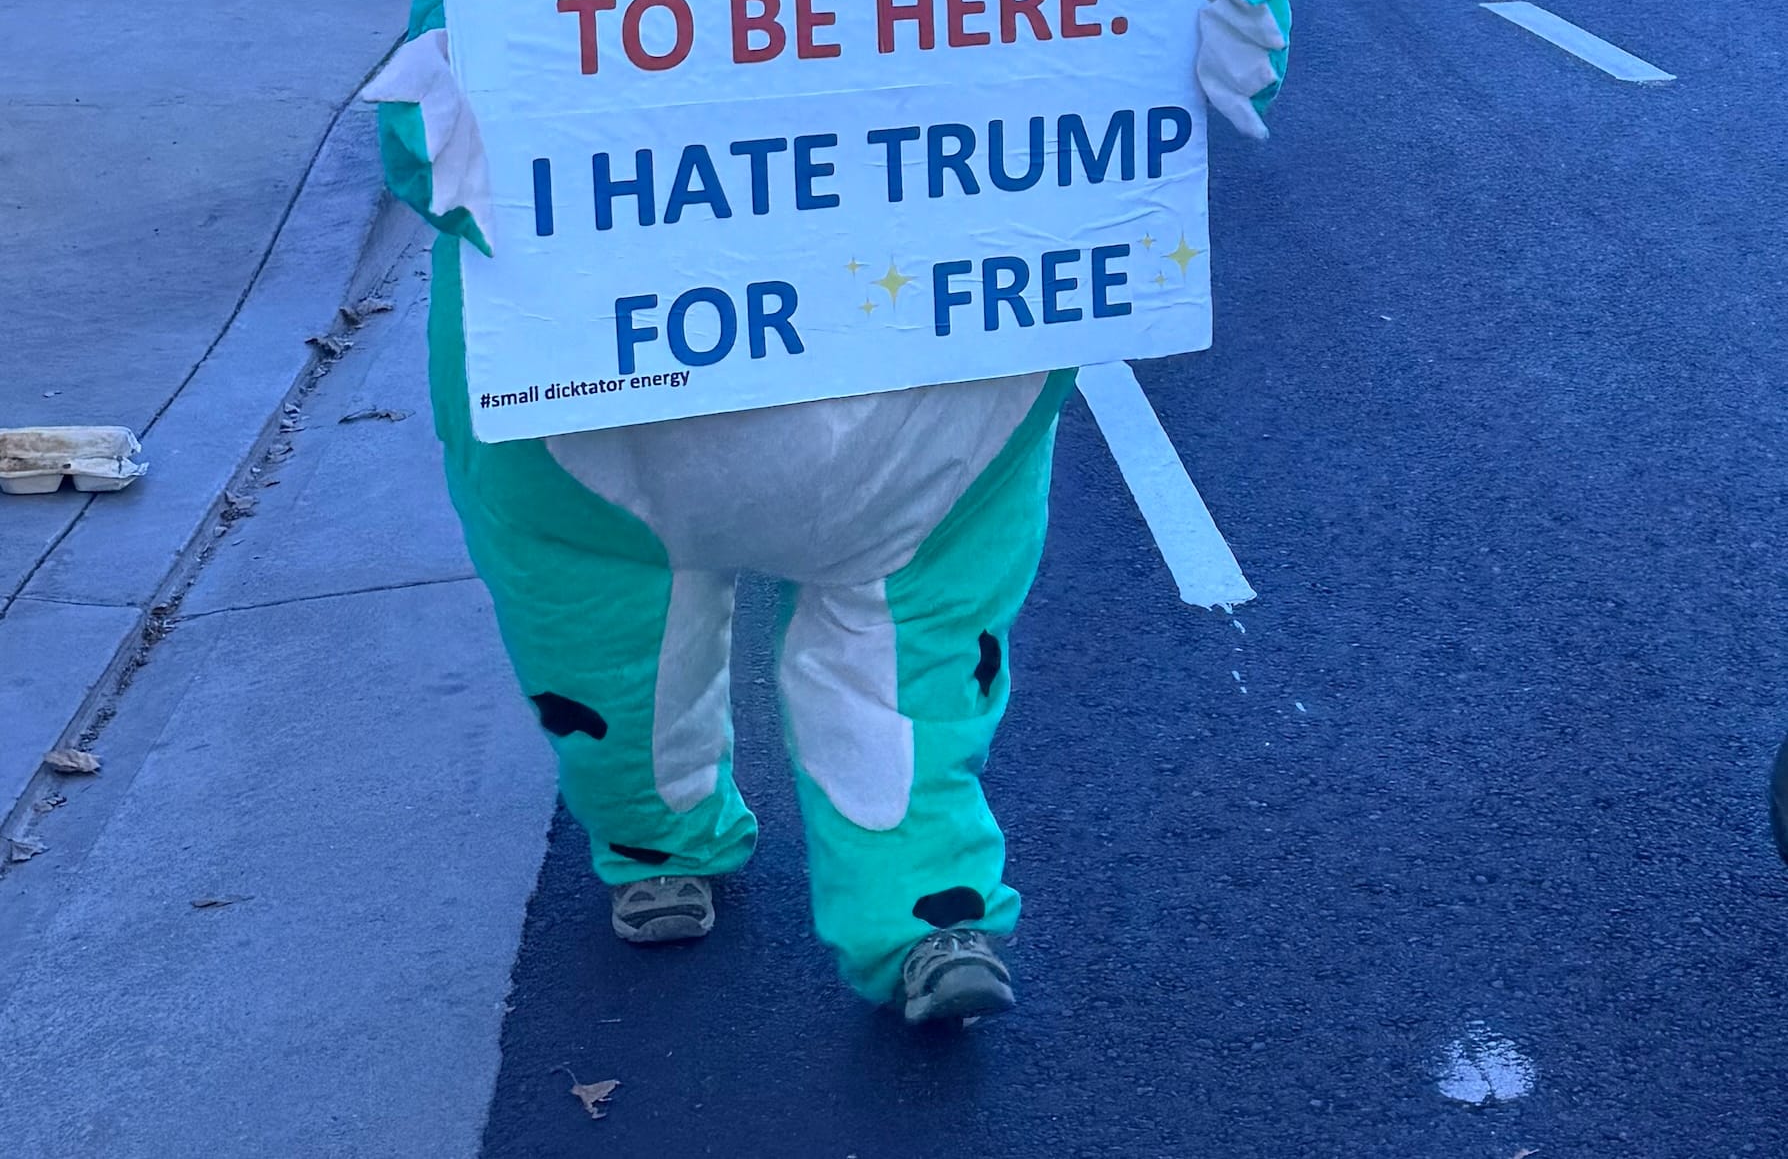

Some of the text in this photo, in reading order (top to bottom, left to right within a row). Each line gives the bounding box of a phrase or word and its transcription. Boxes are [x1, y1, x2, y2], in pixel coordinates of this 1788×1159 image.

[533, 106, 1193, 238] I HATE TRUMP
[615, 244, 1133, 376] FOR FREE
[480, 370, 691, 409] #small dicktator energy
